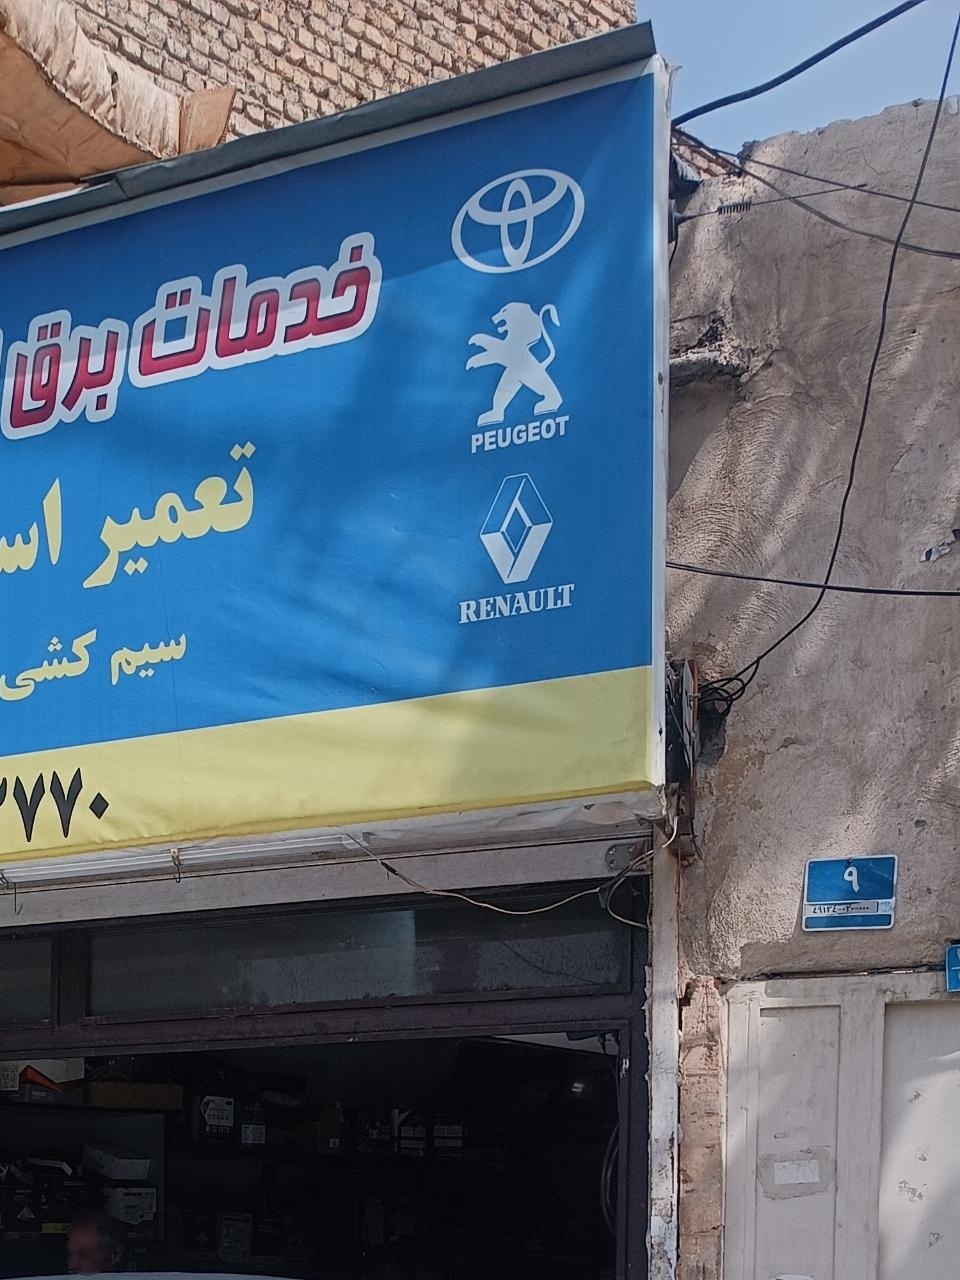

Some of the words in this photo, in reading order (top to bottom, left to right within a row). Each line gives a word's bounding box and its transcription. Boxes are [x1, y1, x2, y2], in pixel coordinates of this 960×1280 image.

[130, 233, 380, 385] خدمات
[5, 314, 124, 434] برق
[471, 415, 570, 454] PEUGEOT
[83, 440, 256, 589] تعمیر
[458, 583, 575, 625] RENAULT
[110, 632, 188, 685] سیم
[843, 866, 860, 893] ۹
